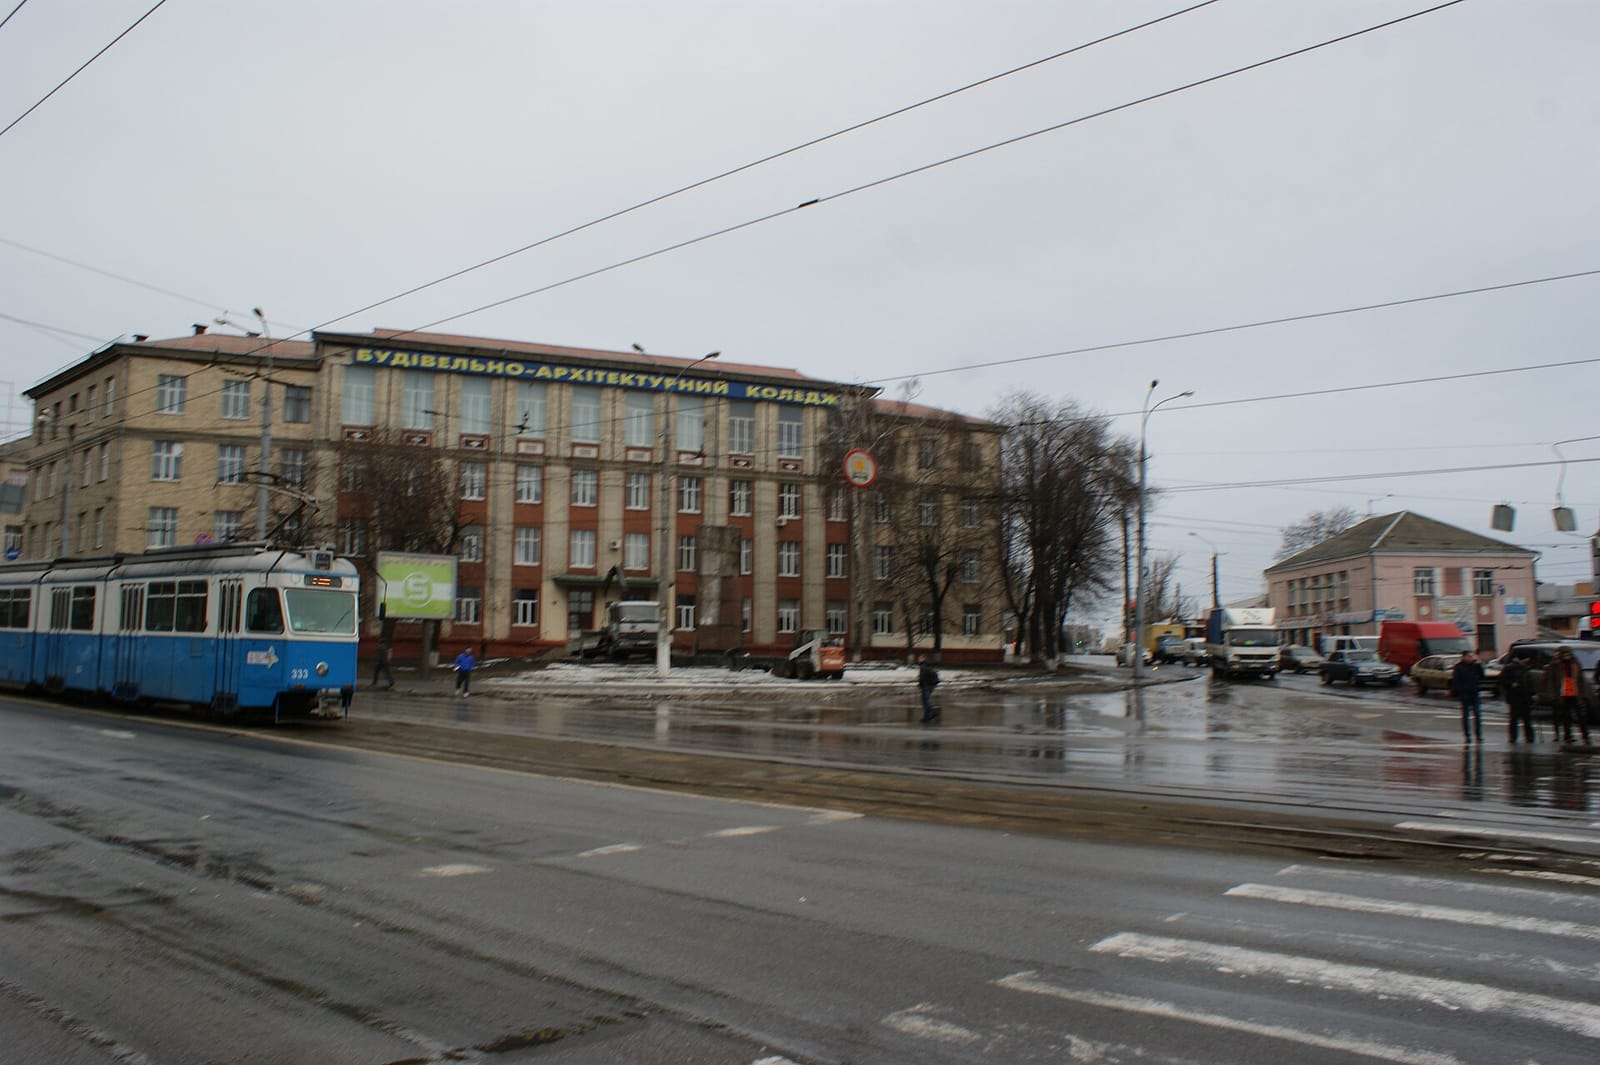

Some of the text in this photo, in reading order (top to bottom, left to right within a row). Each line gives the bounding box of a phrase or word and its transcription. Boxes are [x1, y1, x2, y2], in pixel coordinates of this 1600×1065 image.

[355, 348, 839, 406] БУДІВЕЛЬНО-АРХІТЕКТУРНИЙ КОЛЕДЖ
[291, 668, 309, 679] 333
